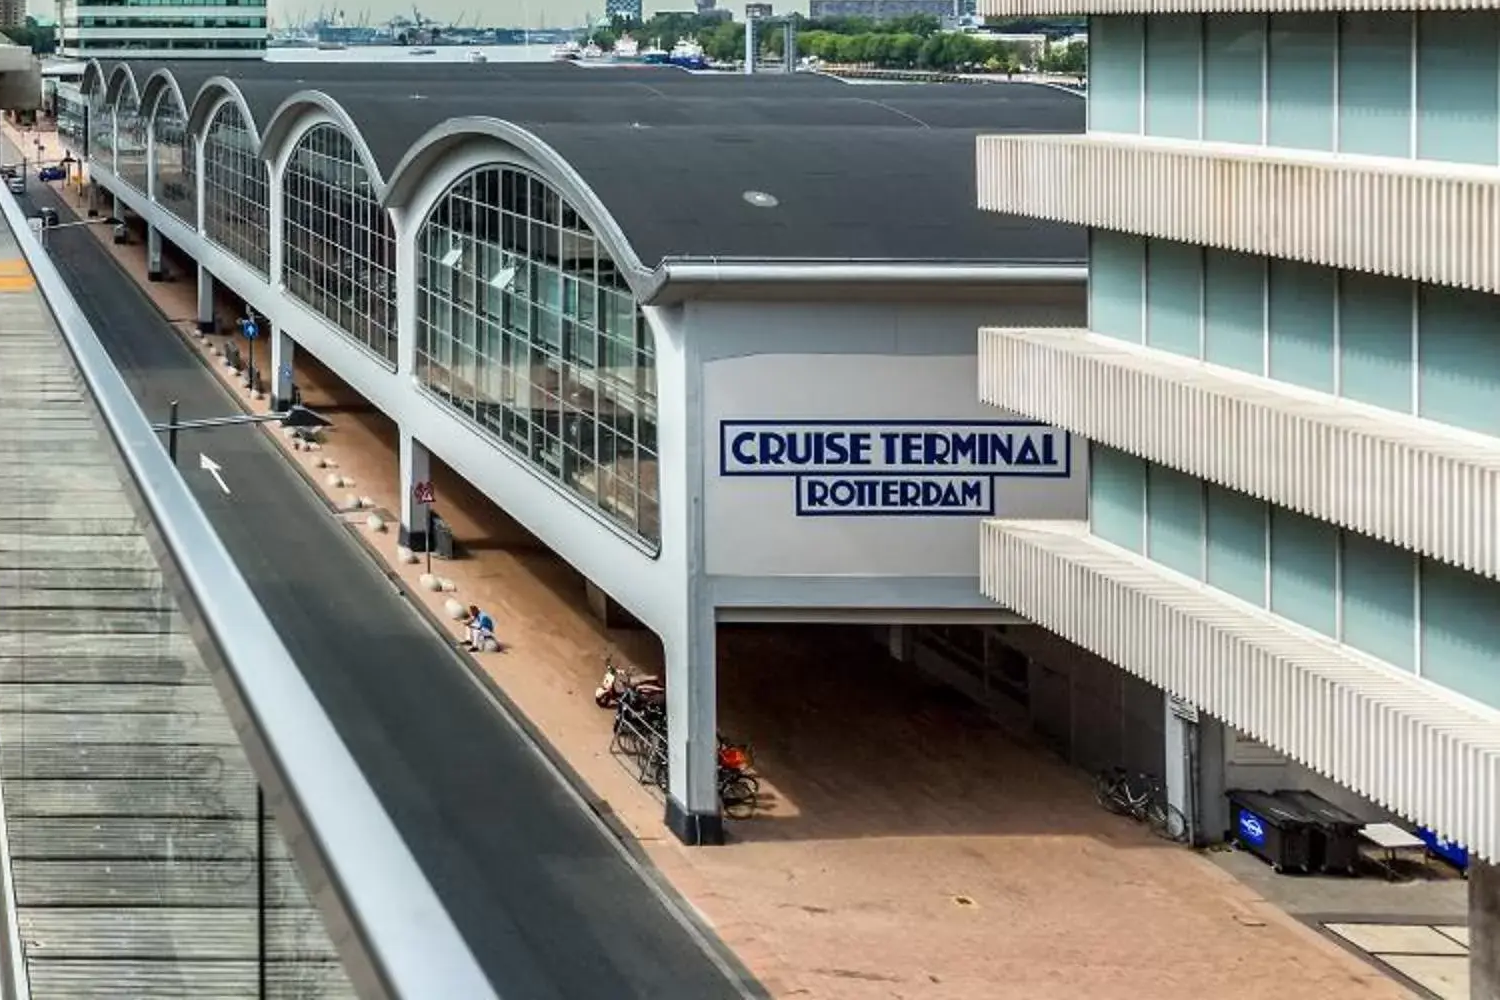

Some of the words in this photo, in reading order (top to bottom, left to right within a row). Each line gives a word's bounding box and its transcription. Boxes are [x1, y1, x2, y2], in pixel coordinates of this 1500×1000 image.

[731, 431, 871, 465] CRUISE
[879, 433, 1058, 465] TERMINAL
[807, 479, 982, 507] ROTTERDAM
